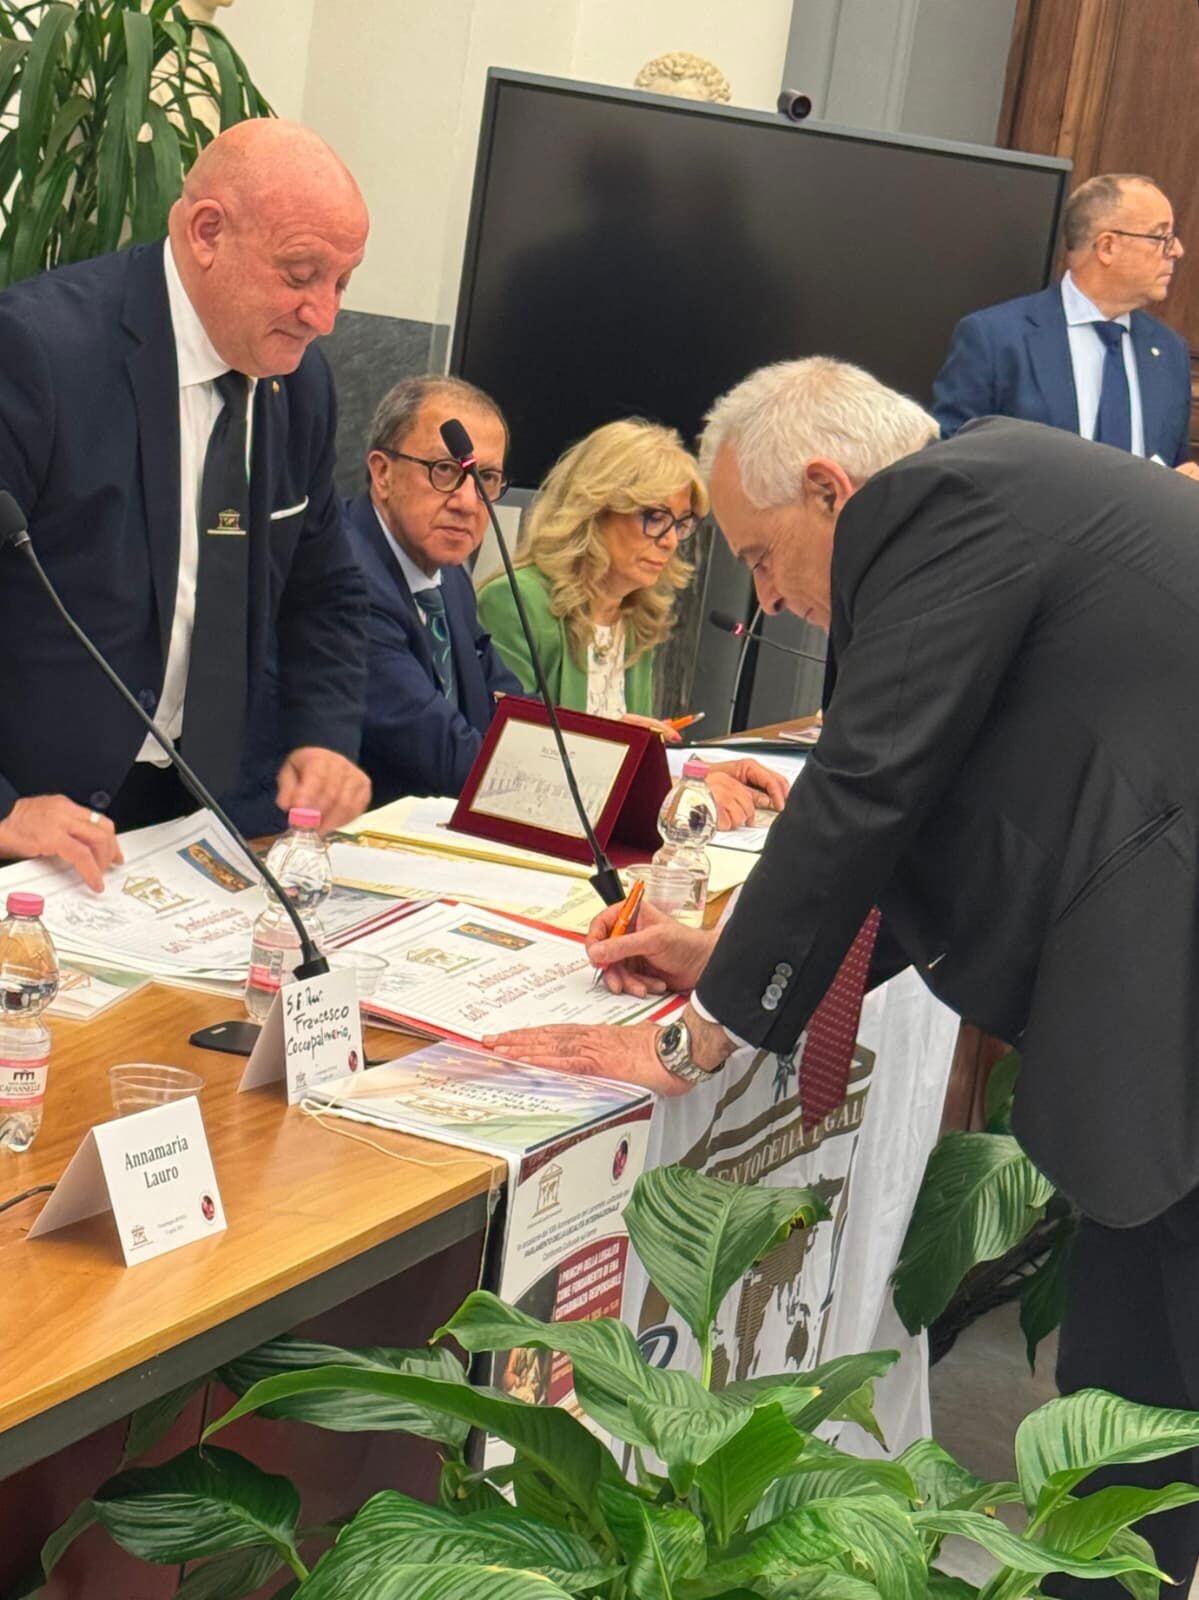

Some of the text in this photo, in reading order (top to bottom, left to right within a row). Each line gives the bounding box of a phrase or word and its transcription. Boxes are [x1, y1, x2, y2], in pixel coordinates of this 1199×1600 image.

[293, 1005, 349, 1034] Francesco
[125, 1135, 189, 1171] Annamaria
[144, 1165, 180, 1189] Lauro
